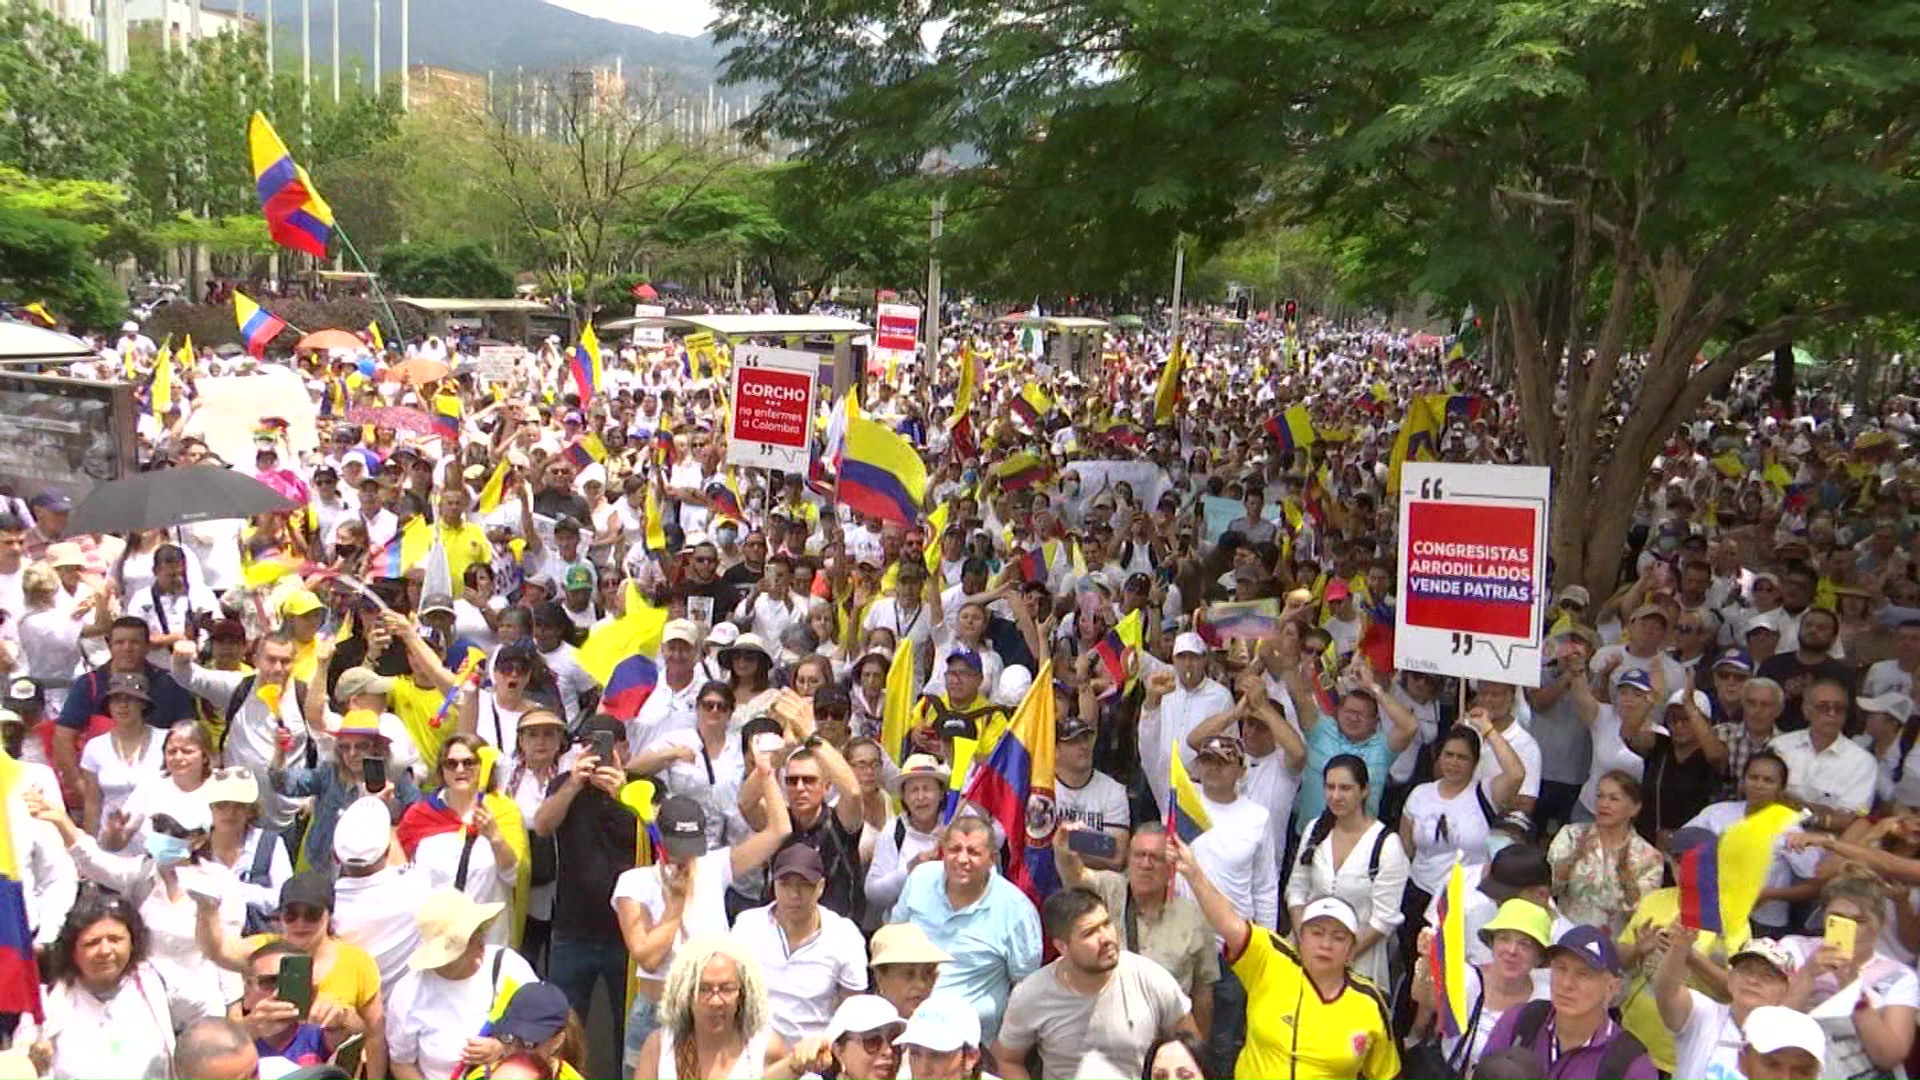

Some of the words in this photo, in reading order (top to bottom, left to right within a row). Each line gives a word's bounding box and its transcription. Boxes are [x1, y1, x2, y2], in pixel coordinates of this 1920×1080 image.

[743, 382, 806, 402] CORCHO
[738, 406, 752, 416] no
[754, 407, 802, 422] enfermes
[751, 418, 800, 434] Colombia
[1412, 541, 1529, 562] CONGRESISTAS
[1410, 560, 1531, 582] ARRODILLADOS
[1410, 577, 1460, 595] VENDE
[1464, 582, 1529, 601] PATRIAS
